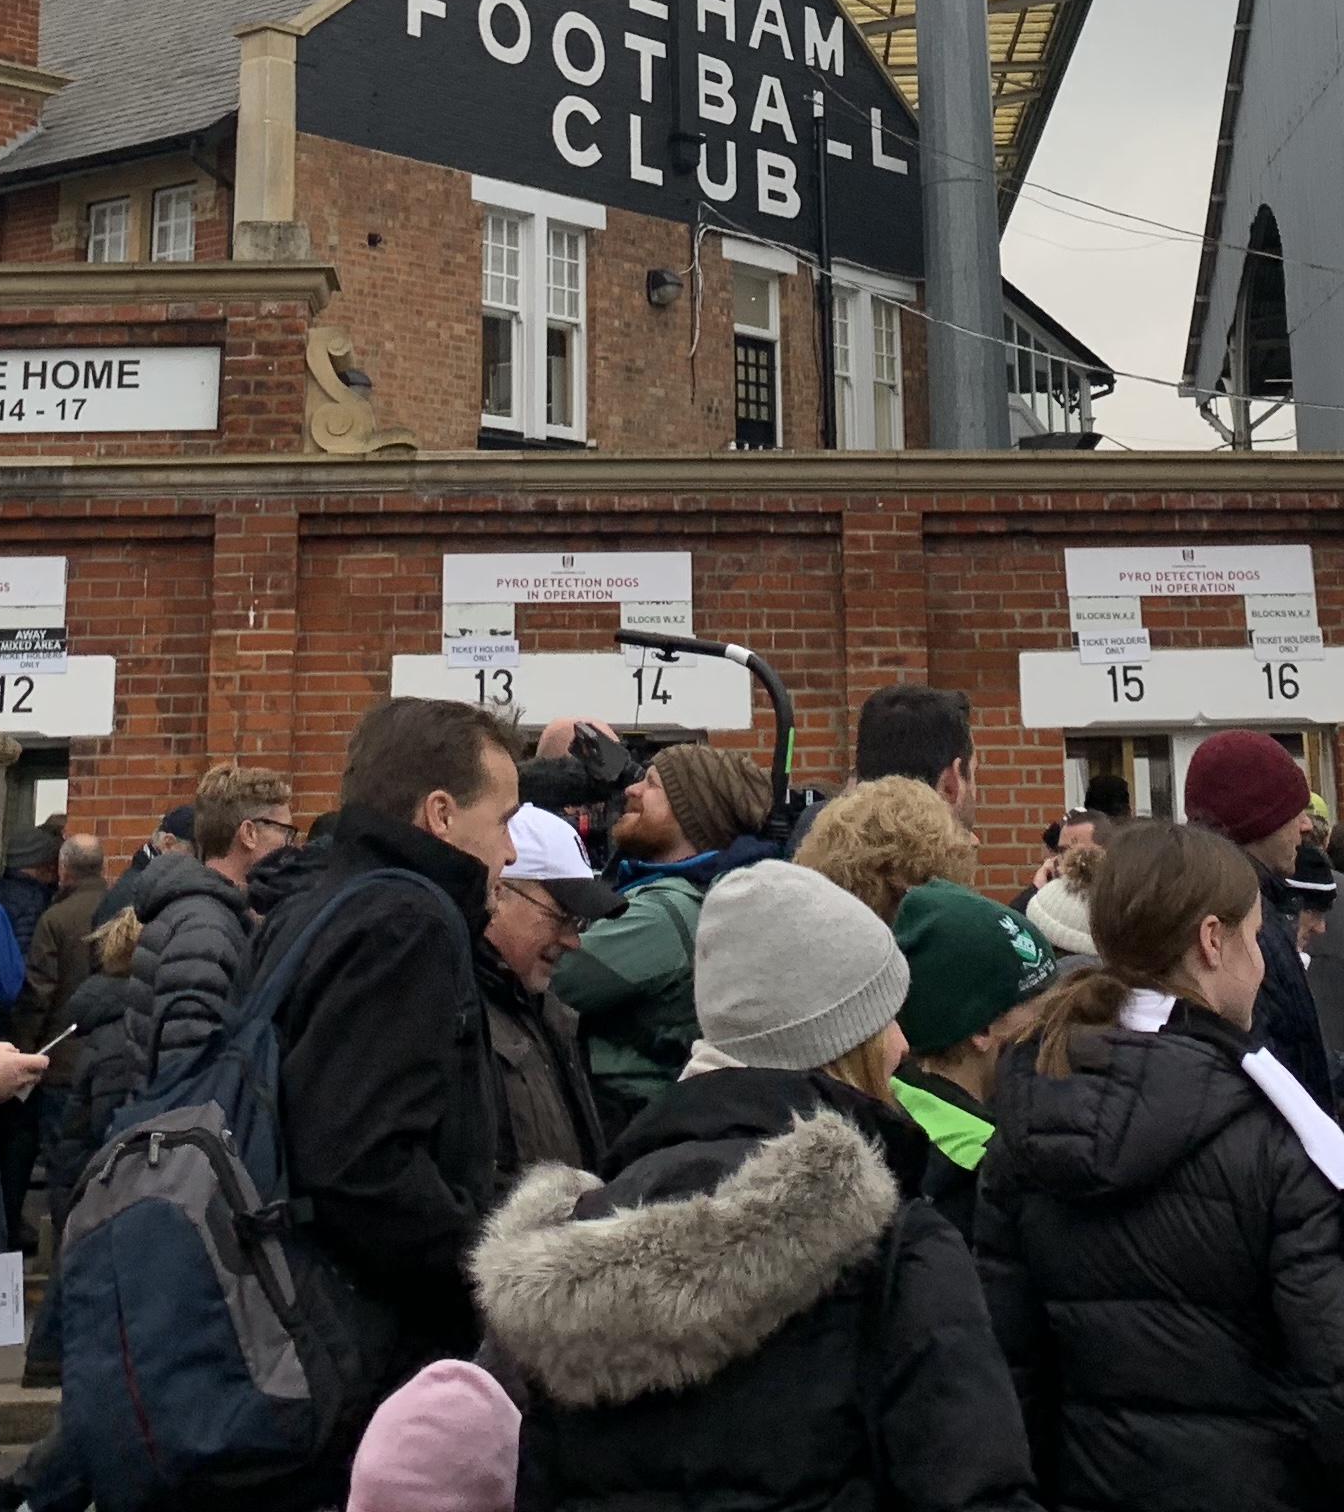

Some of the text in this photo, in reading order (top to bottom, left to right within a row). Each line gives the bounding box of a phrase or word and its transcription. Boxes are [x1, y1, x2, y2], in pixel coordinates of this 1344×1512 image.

[552, 95, 801, 219] CLUB
[22, 359, 141, 390] HOME
[55, 398, 87, 421] 17
[1119, 570, 1260, 581] PYRO DETECTION DOGS
[496, 577, 639, 588] PYRO DETECTION DOGS
[1150, 583, 1235, 593] IN OPERATION
[527, 590, 613, 600] IN OPERATION
[627, 615, 661, 623] BLOCKS
[15, 629, 46, 640] AWAY
[1256, 635, 1321, 644] TICKET HOLDERS
[0, 640, 61, 651] MIXED AREA
[1082, 636, 1147, 646] TICKET HOLDERS
[451, 645, 515, 654] TICKET HOLDERS
[1105, 646, 1125, 655] ONLY
[473, 654, 493, 662] ONLY
[475, 666, 672, 706] 13 14
[1107, 663, 1300, 702] 15 16
